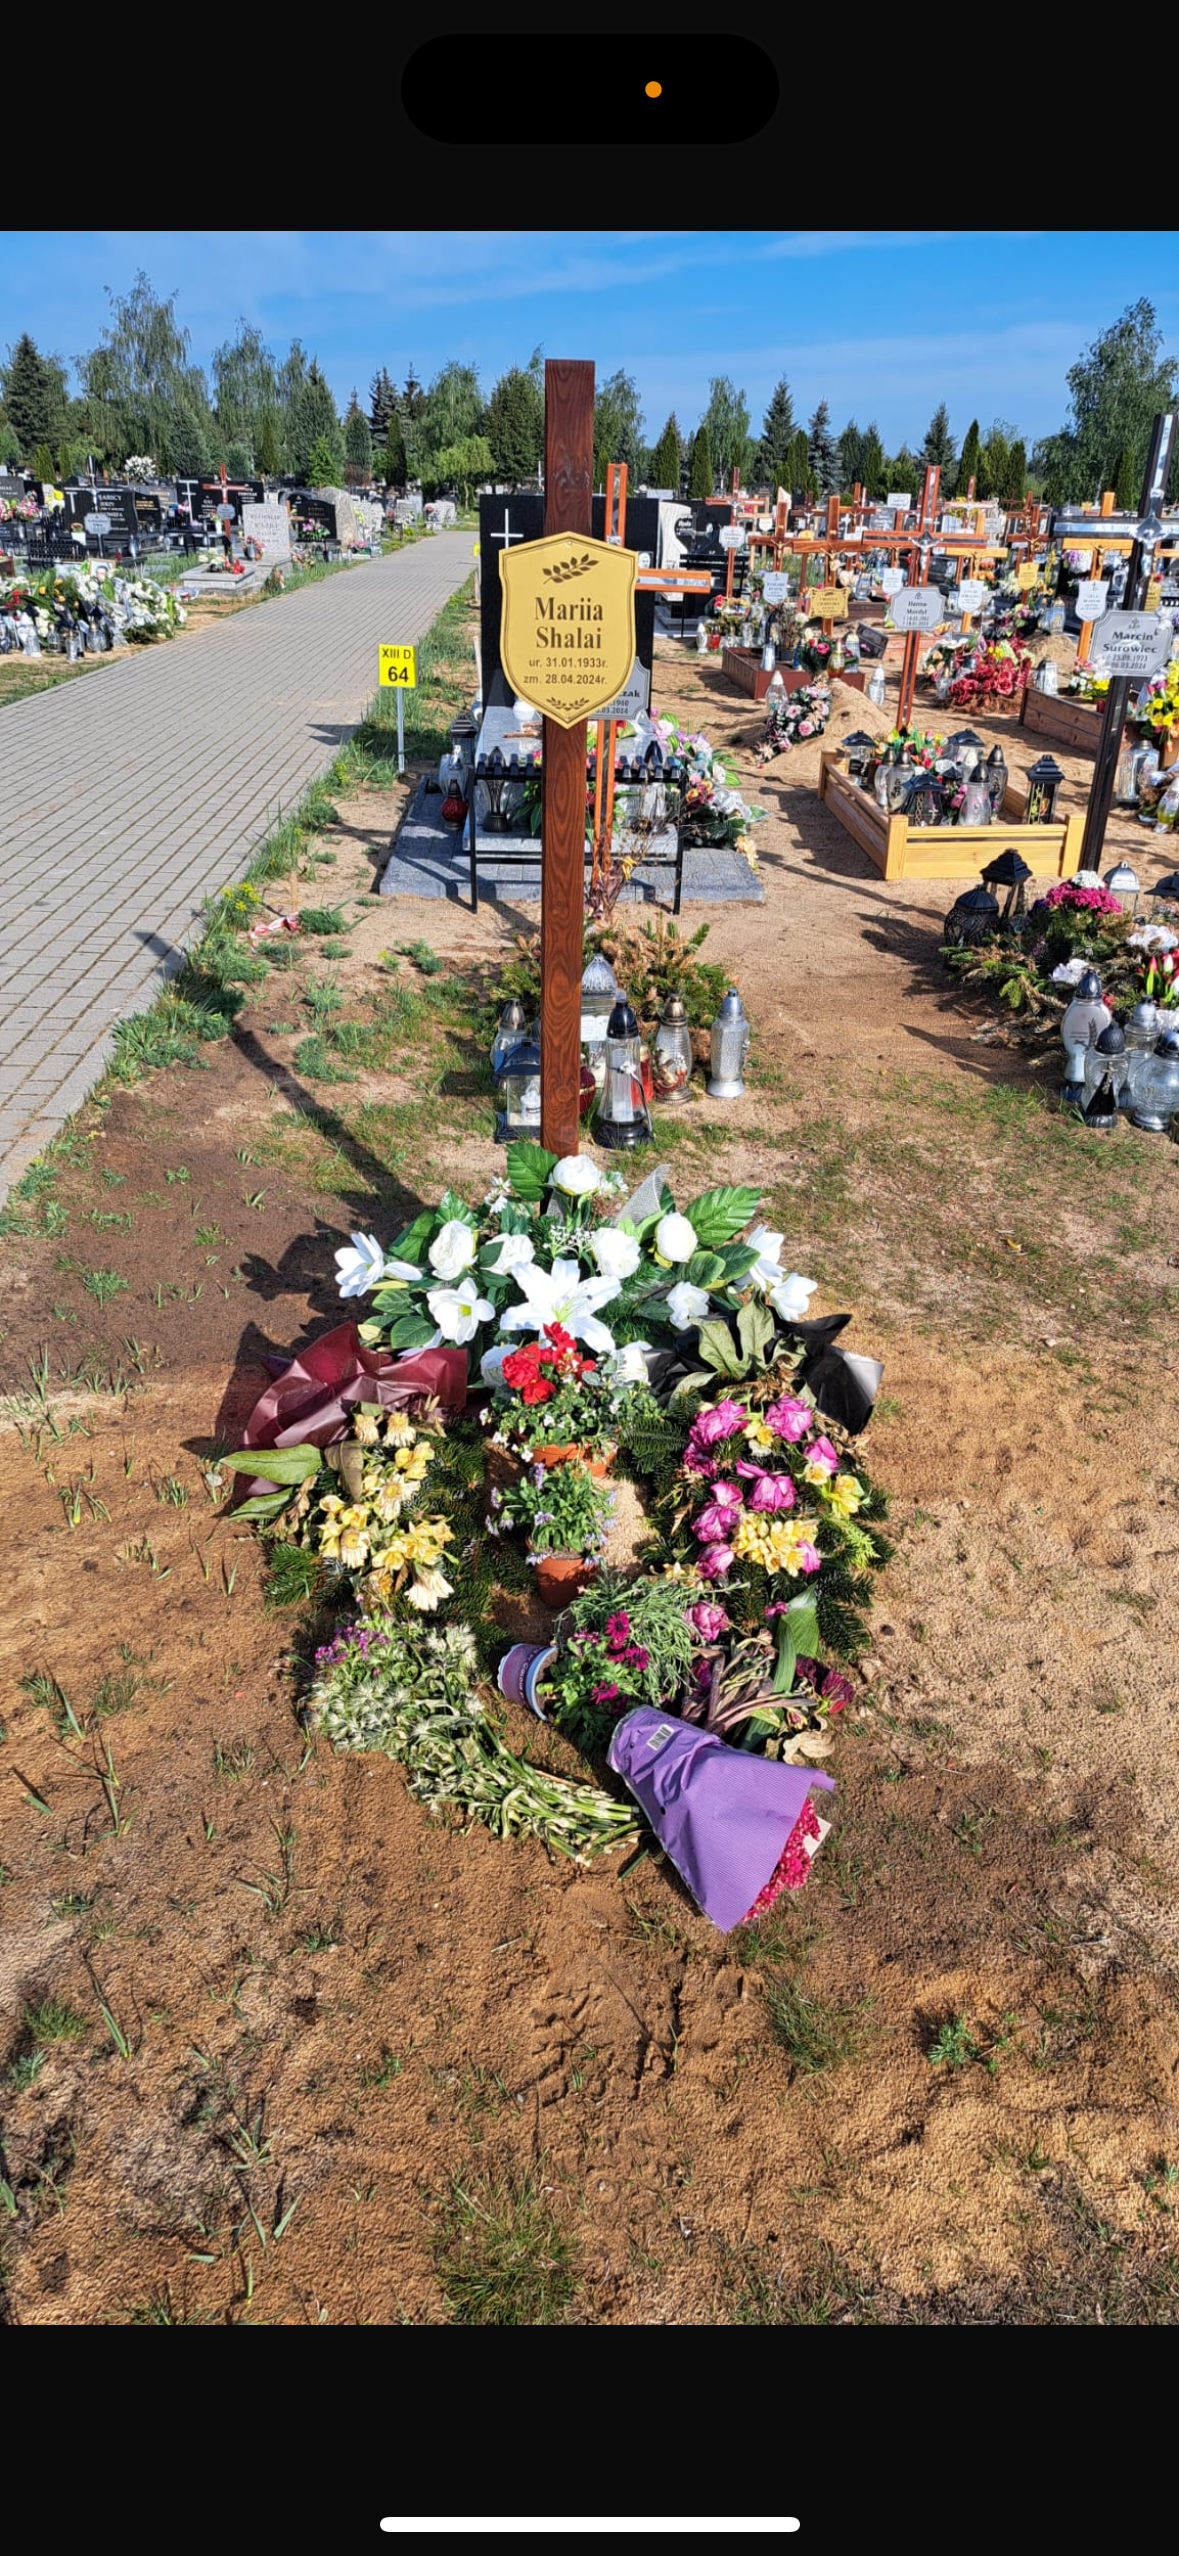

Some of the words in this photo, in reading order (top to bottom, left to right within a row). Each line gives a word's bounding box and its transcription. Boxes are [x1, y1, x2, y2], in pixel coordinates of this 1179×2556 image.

[534, 597, 604, 621] Mariia
[536, 626, 602, 649] Shalai
[1112, 631, 1154, 641] Marcin
[381, 648, 399, 658] XIII
[403, 649, 411, 659] D
[1103, 643, 1158, 654] Surowiec
[529, 659, 543, 668] ur.
[546, 657, 609, 669] 31.01.1933r.
[388, 665, 409, 682] 64
[523, 675, 542, 684] zm.
[545, 674, 608, 685] 28.04.2024r.
